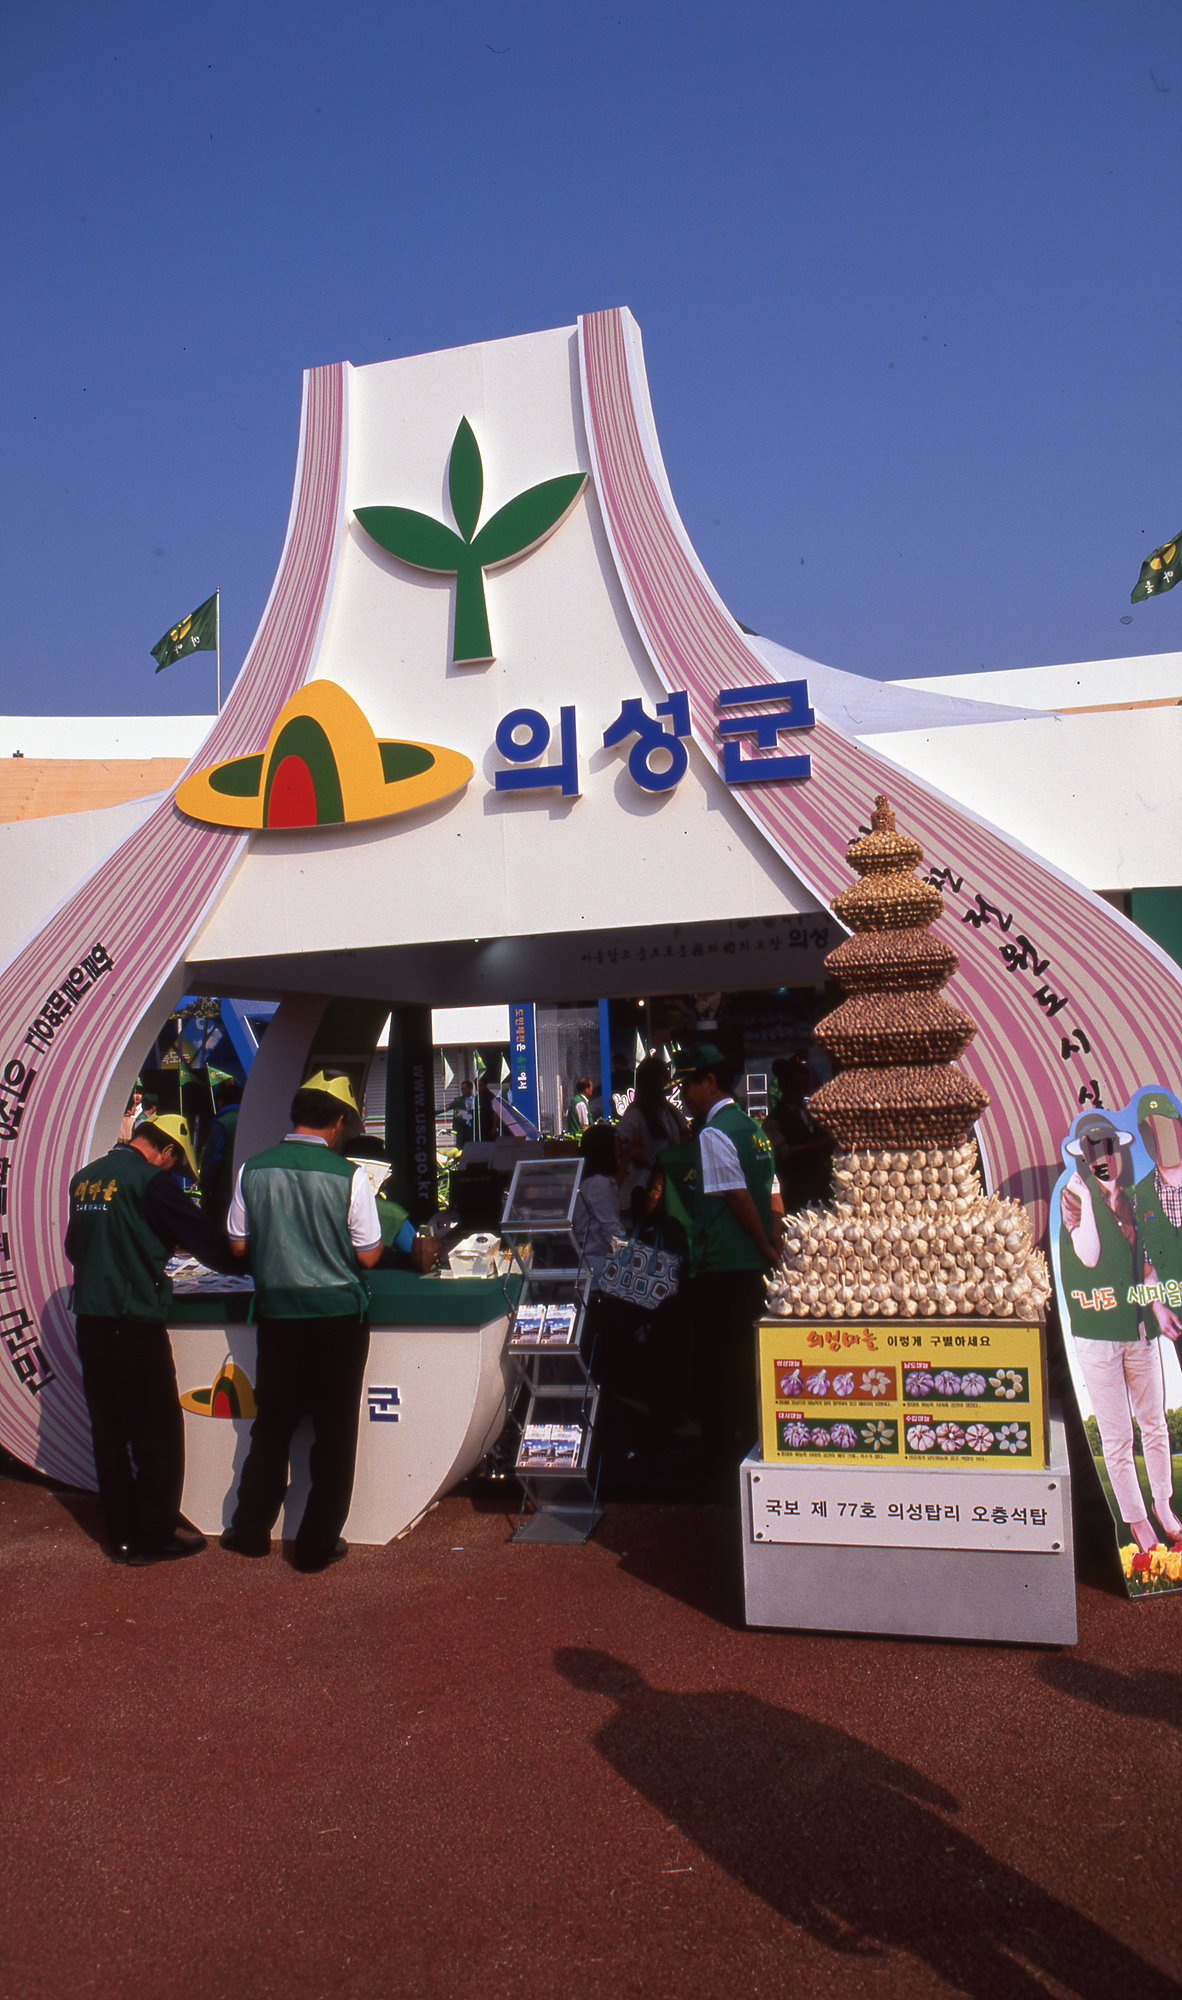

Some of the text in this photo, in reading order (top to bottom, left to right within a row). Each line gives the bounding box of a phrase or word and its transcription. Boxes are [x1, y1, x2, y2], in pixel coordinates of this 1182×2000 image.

[495, 679, 816, 797] 의성군
[581, 945, 631, 964] 아름답고
[755, 935, 783, 951] 고장
[788, 927, 829, 949] 의성
[413, 1064, 431, 1199] www.usc.go.kr
[74, 1179, 118, 1201] 새마을
[806, 1327, 991, 1352] 의성마늘 이렇게 구별하세요
[765, 1499, 1048, 1526] 국보 제 77호 의성탑리 오층석탑
